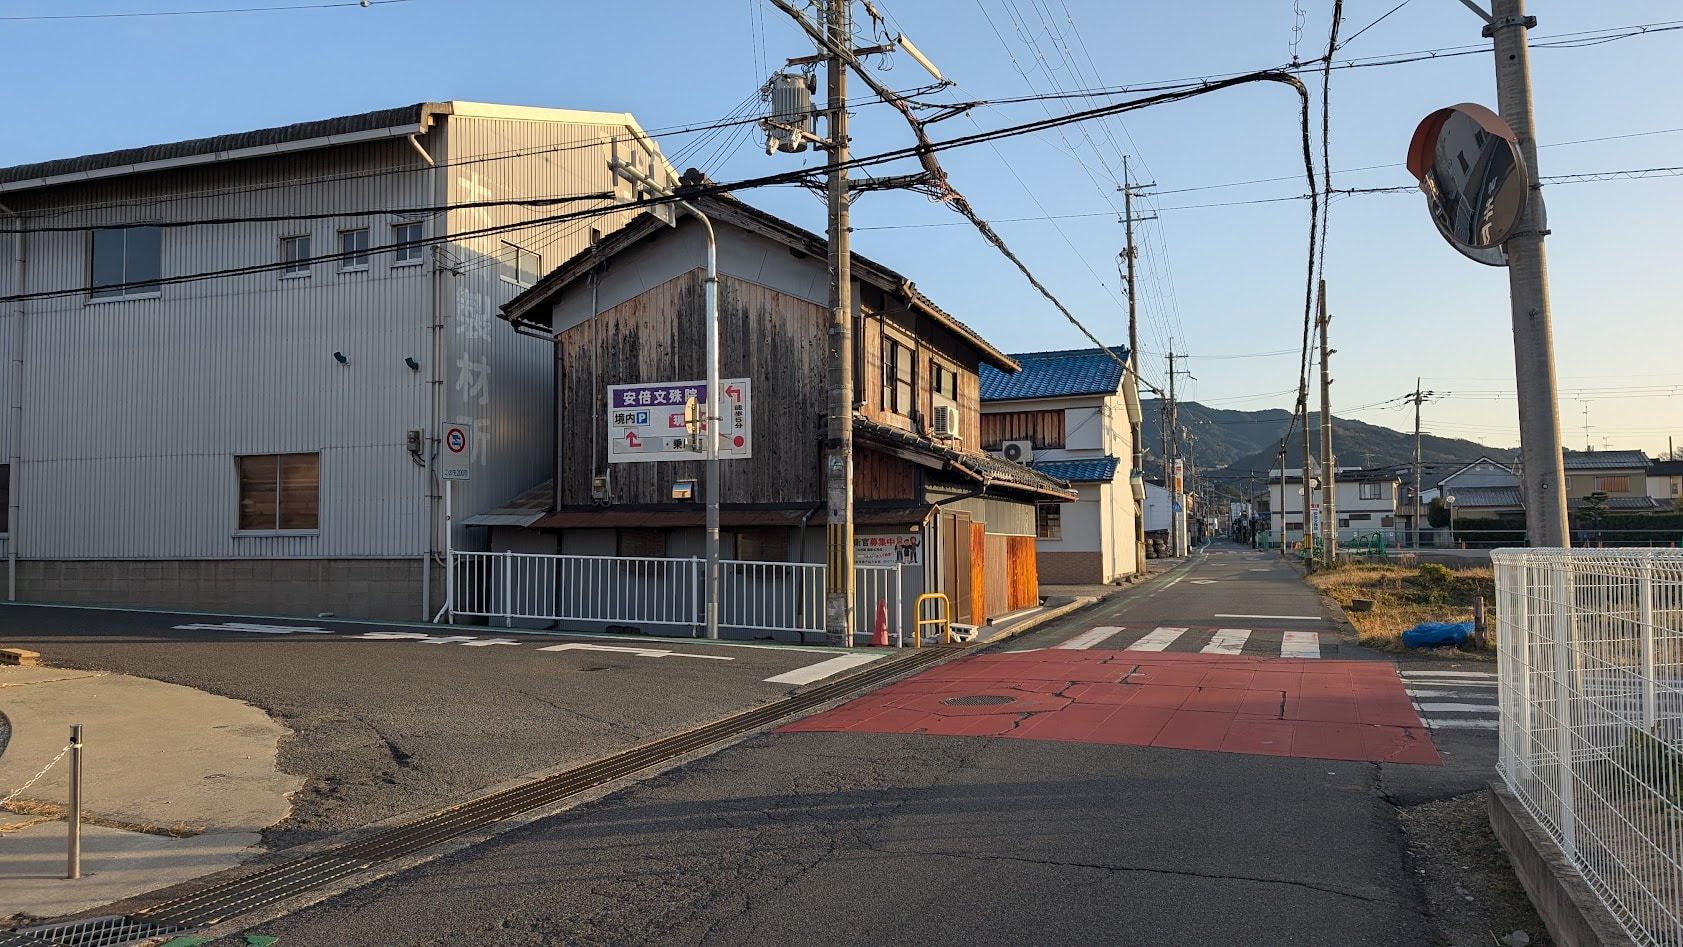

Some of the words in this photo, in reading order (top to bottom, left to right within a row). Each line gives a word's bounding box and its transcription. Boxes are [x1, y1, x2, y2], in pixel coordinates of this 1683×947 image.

[623, 388, 698, 406] 安倍文殊院
[614, 413, 636, 425] 境内
